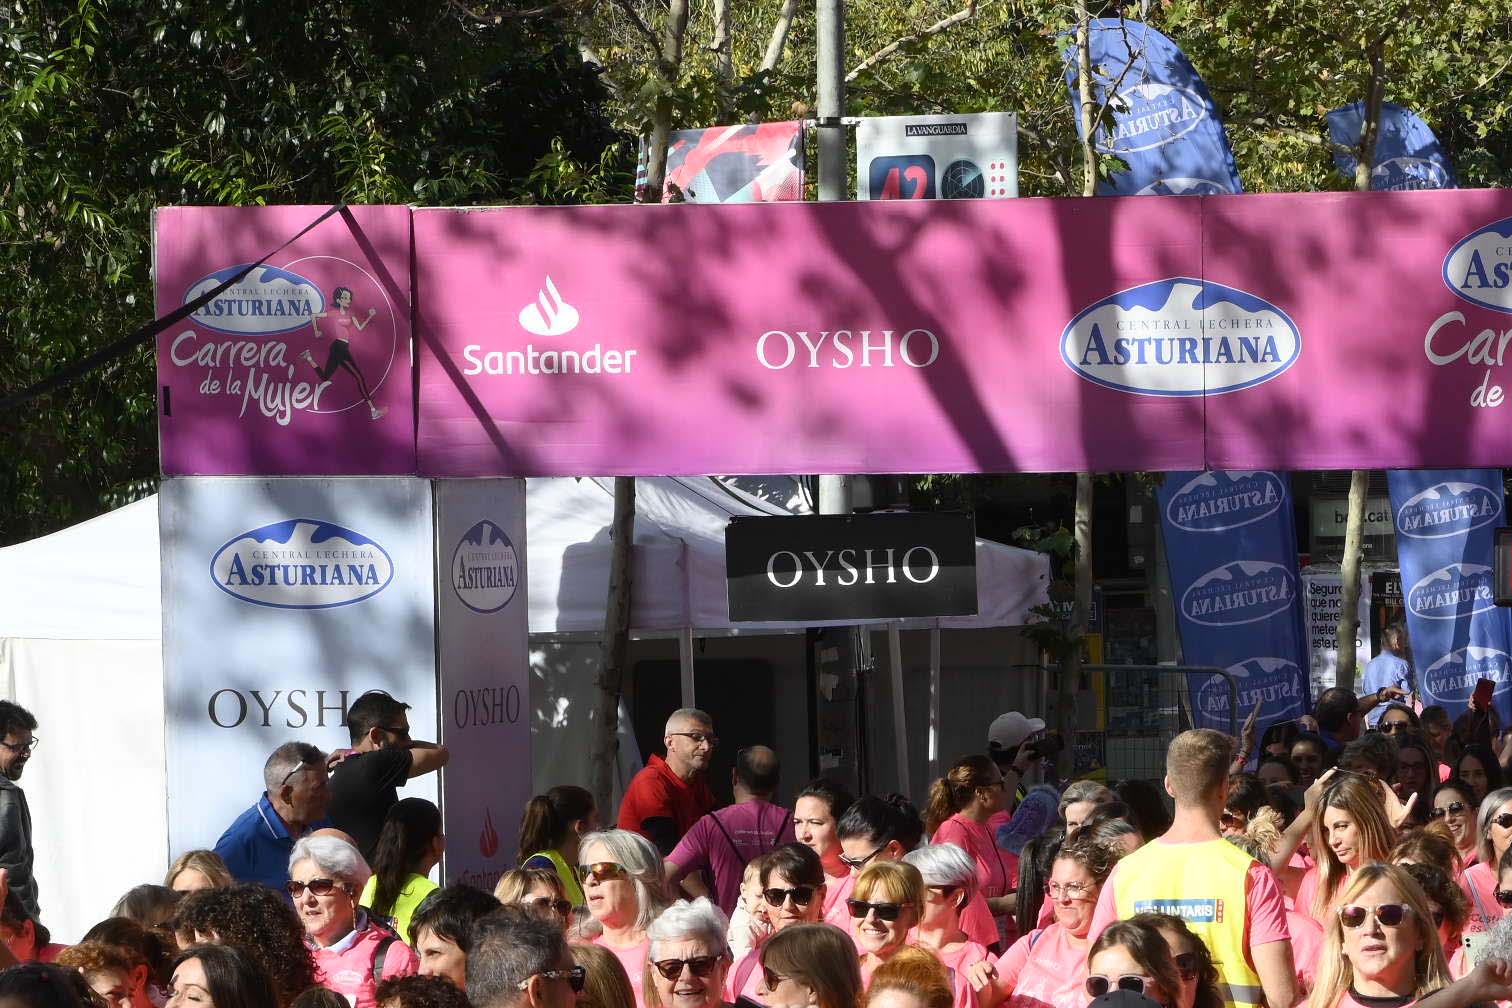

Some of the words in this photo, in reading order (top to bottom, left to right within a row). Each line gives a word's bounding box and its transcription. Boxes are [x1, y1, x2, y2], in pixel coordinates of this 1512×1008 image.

[1116, 319, 1192, 331] CENTRAL
[1198, 317, 1275, 330] LECHERA
[171, 331, 288, 367] Carrera
[463, 344, 636, 375] Santander
[755, 328, 940, 369] OYSHO
[1079, 321, 1282, 366] ASTURIANA
[200, 369, 220, 395] de
[226, 369, 241, 395] la
[239, 366, 332, 426] Mujer
[1470, 370, 1504, 408] de
[1335, 510, 1390, 524] b.cat
[225, 552, 380, 587] ASTURIANA
[252, 550, 313, 560] CENTRAL
[315, 549, 374, 559] LECHERA
[457, 554, 515, 590] ASTURIANA
[767, 545, 939, 588] OYSHO
[1311, 599, 1331, 611] que
[1311, 611, 1343, 624] quiere
[1313, 638, 1331, 649] este
[208, 688, 391, 728] OYSH
[454, 684, 521, 729] OYSHO
